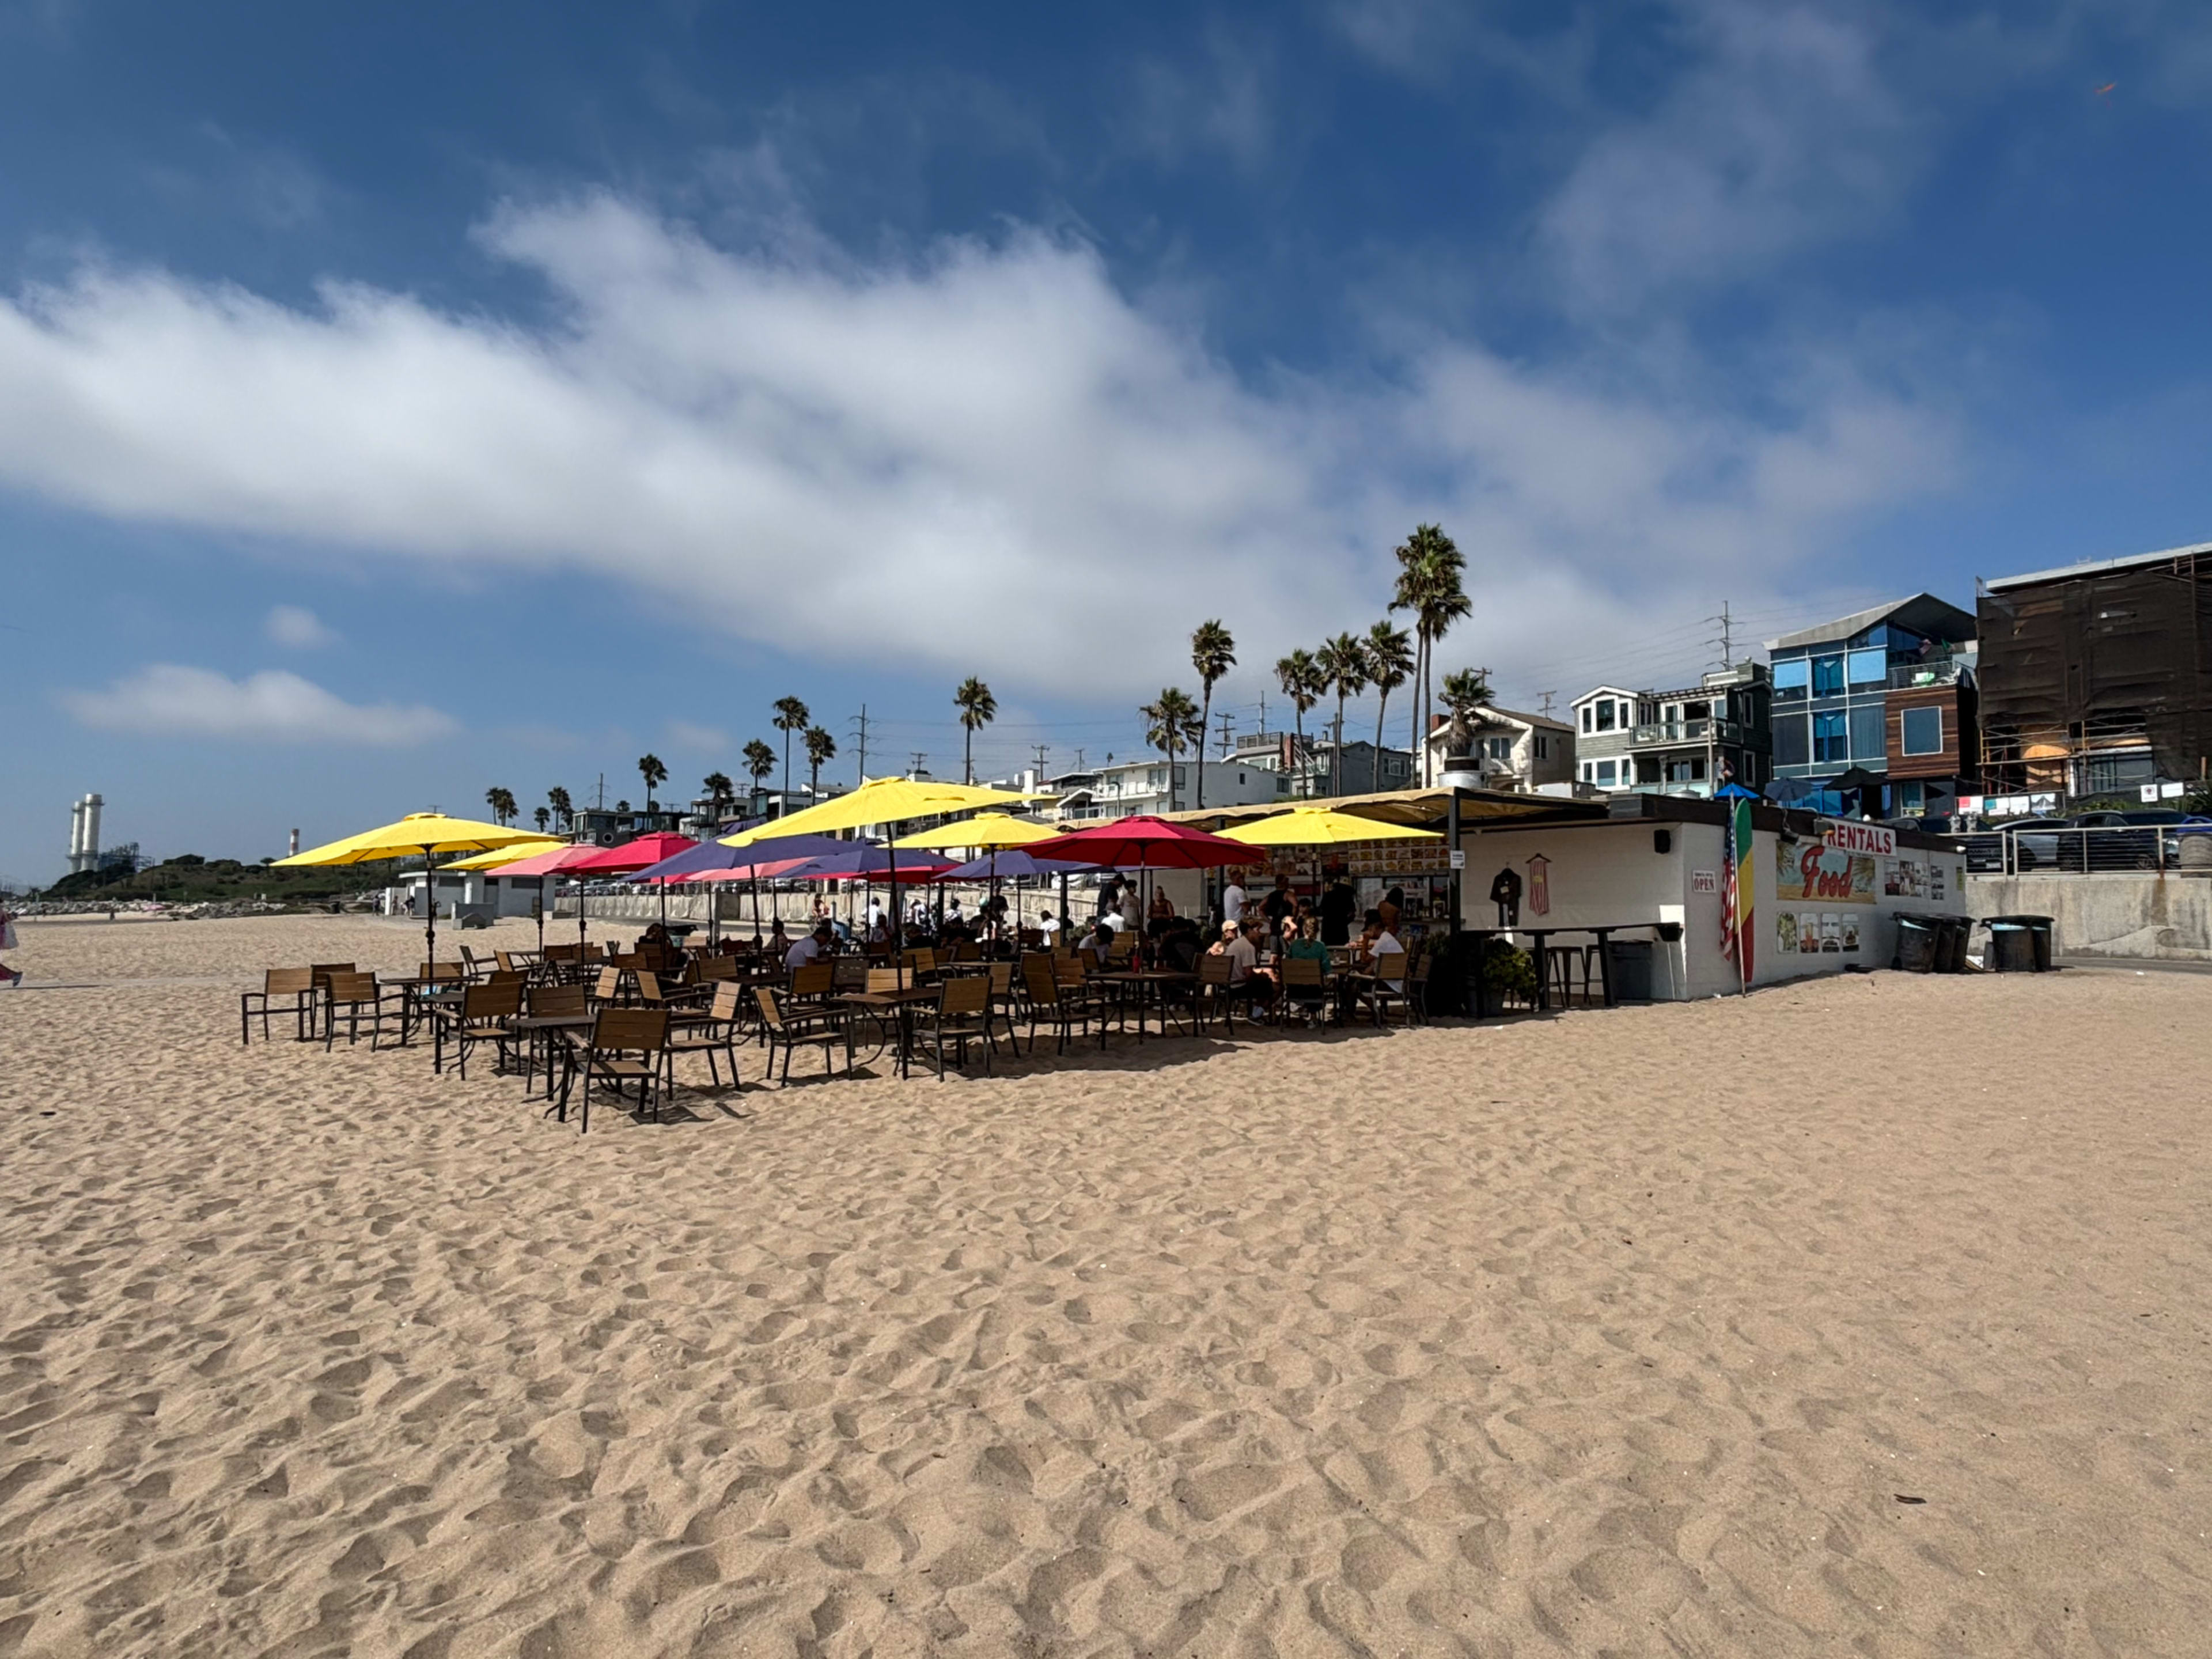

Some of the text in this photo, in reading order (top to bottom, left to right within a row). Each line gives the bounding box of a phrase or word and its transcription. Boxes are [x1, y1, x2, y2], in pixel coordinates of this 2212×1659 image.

[1828, 824, 1892, 854] RENTALS
[1694, 877, 1714, 891] OPEN
[1801, 845, 1853, 898] Food
